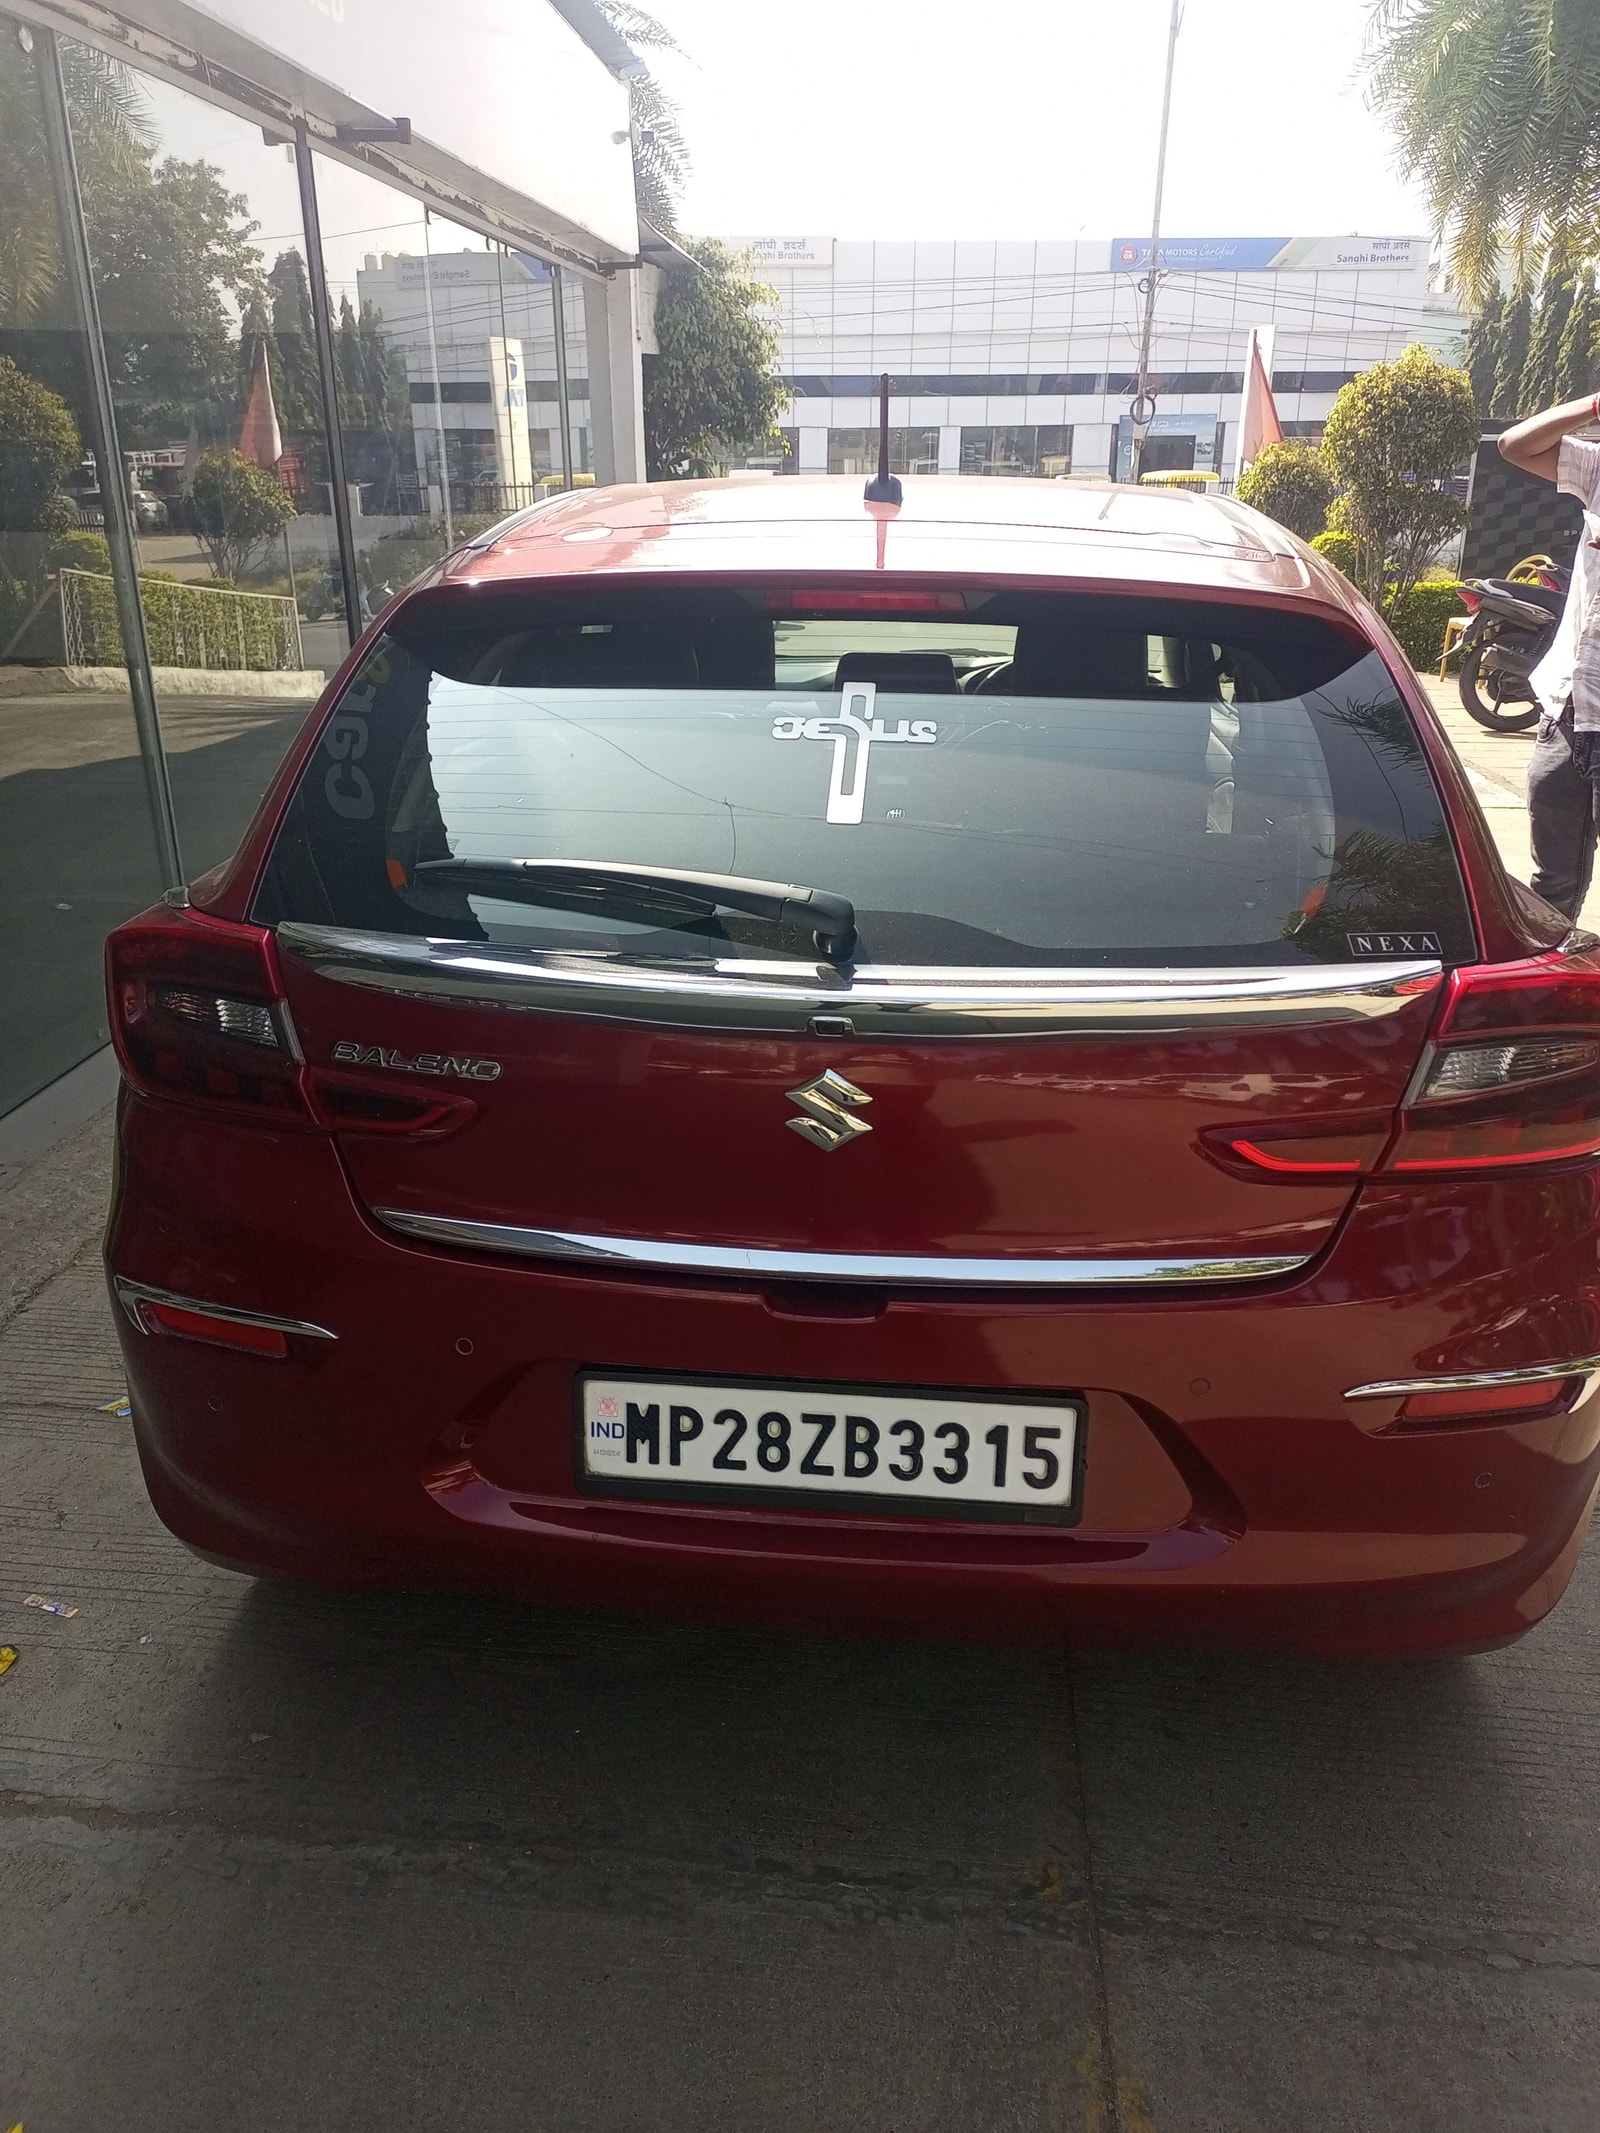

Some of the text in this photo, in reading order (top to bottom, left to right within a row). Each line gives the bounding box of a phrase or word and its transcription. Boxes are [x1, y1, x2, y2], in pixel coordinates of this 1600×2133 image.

[778, 251, 815, 260] Brothers
[1166, 249, 1198, 257] MOTORS
[1199, 243, 1238, 260] Certified
[1337, 253, 1410, 263] Sanghi Brothers
[1356, 935, 1437, 952] NEXA
[332, 1041, 503, 1082] BALENO
[591, 1421, 625, 1439] IND
[626, 1402, 1061, 1490] MP28ZB3315
